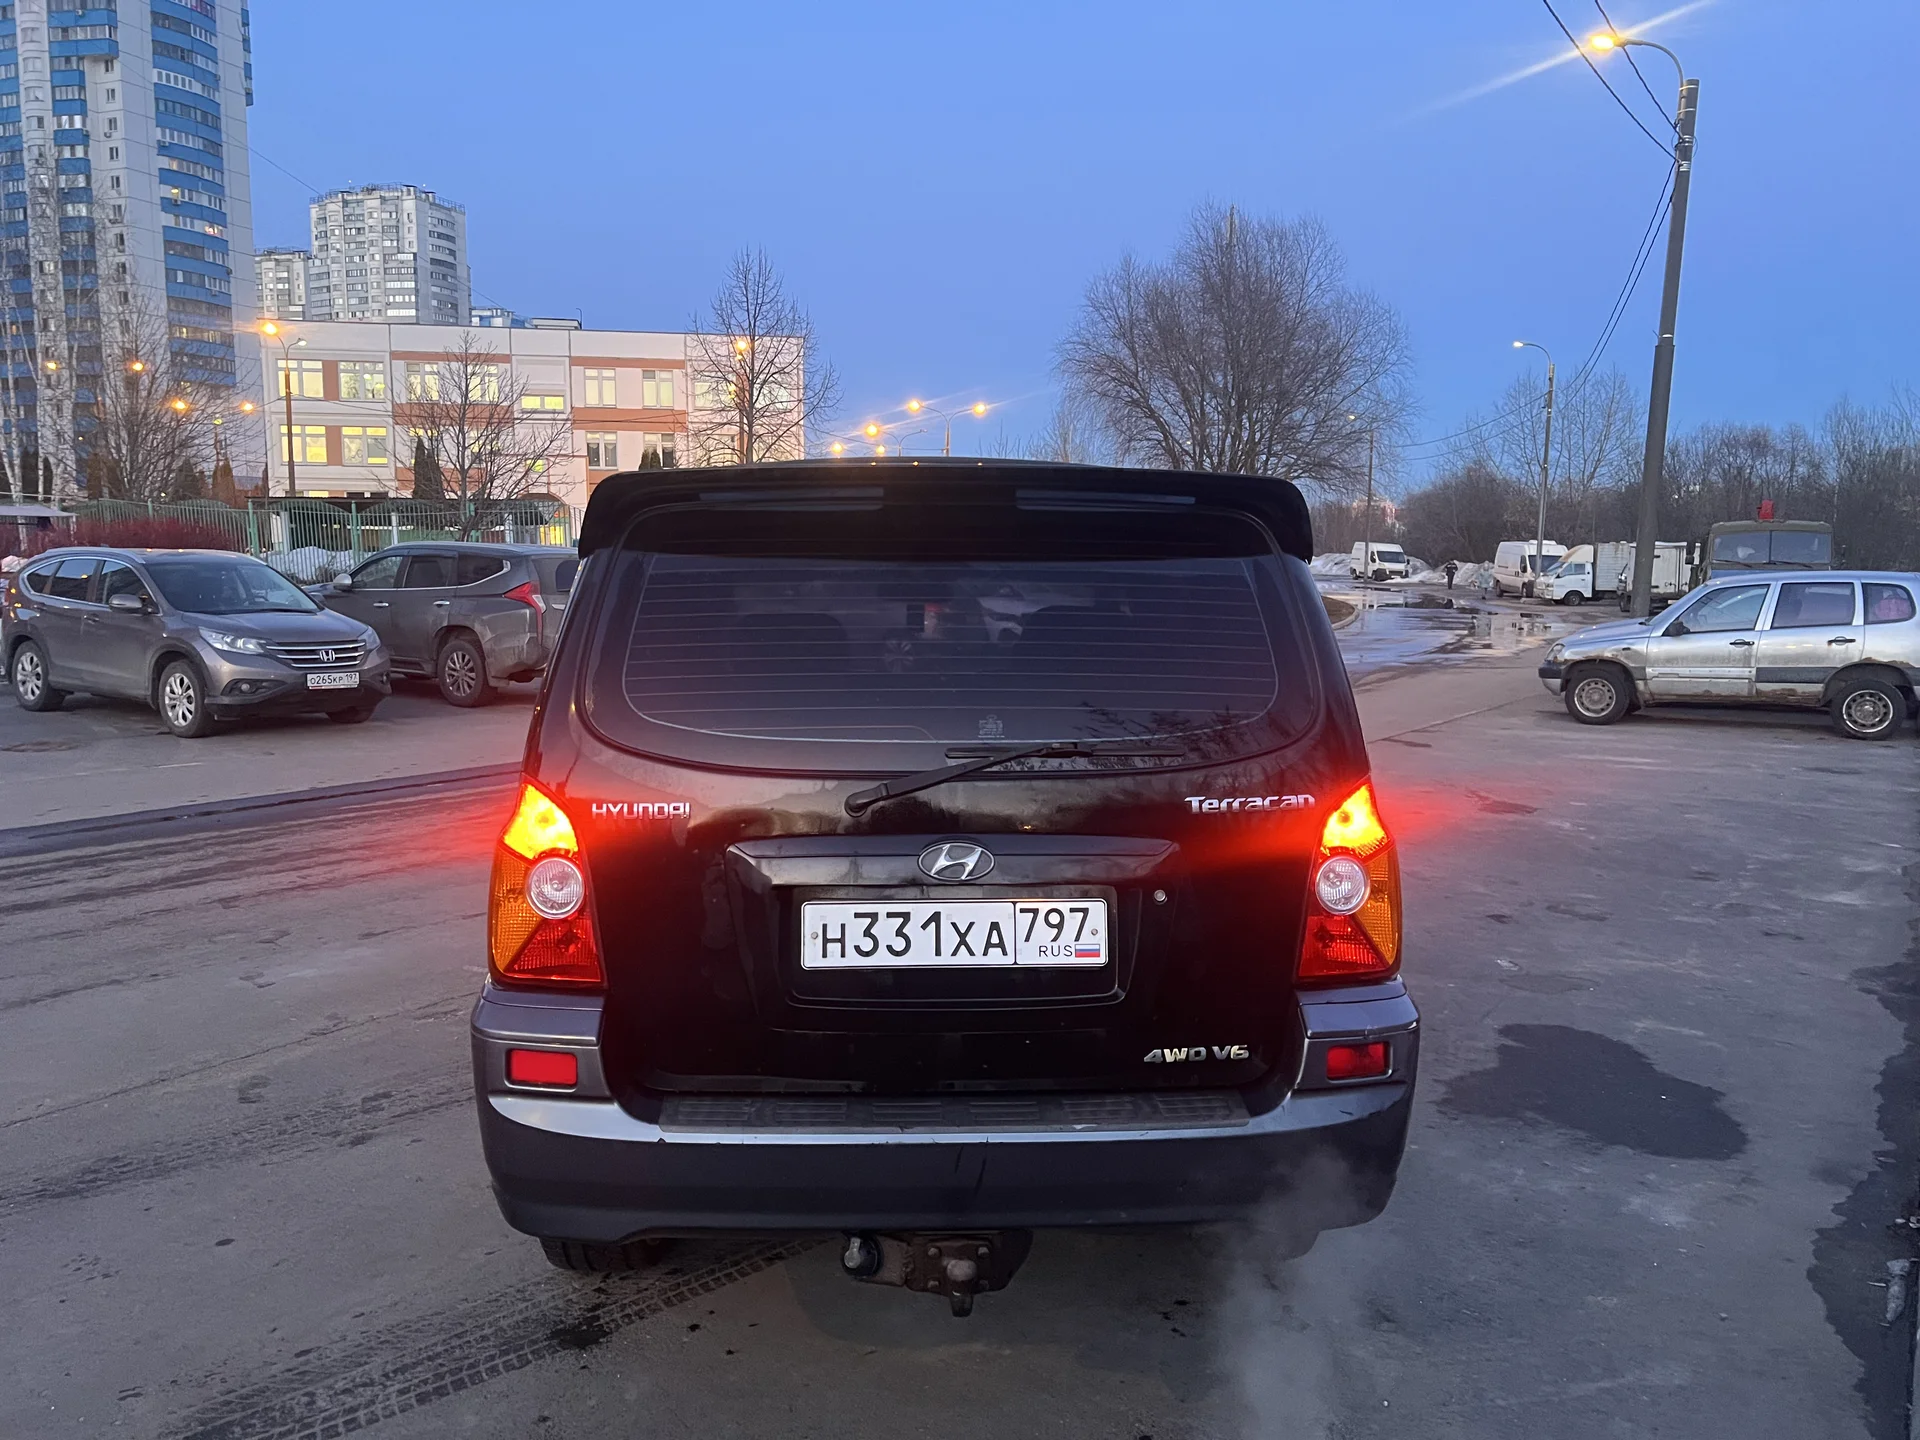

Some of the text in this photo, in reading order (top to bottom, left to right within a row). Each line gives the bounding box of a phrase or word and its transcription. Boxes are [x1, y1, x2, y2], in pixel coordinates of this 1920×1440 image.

[310, 673, 357, 685] О265КР 197
[591, 802, 690, 820] HYUNDAI
[1184, 794, 1316, 814] Terracan
[821, 907, 1090, 959] Н331ХА 797
[1038, 945, 1073, 957] RUS
[1143, 1044, 1250, 1063] 4WD V6
